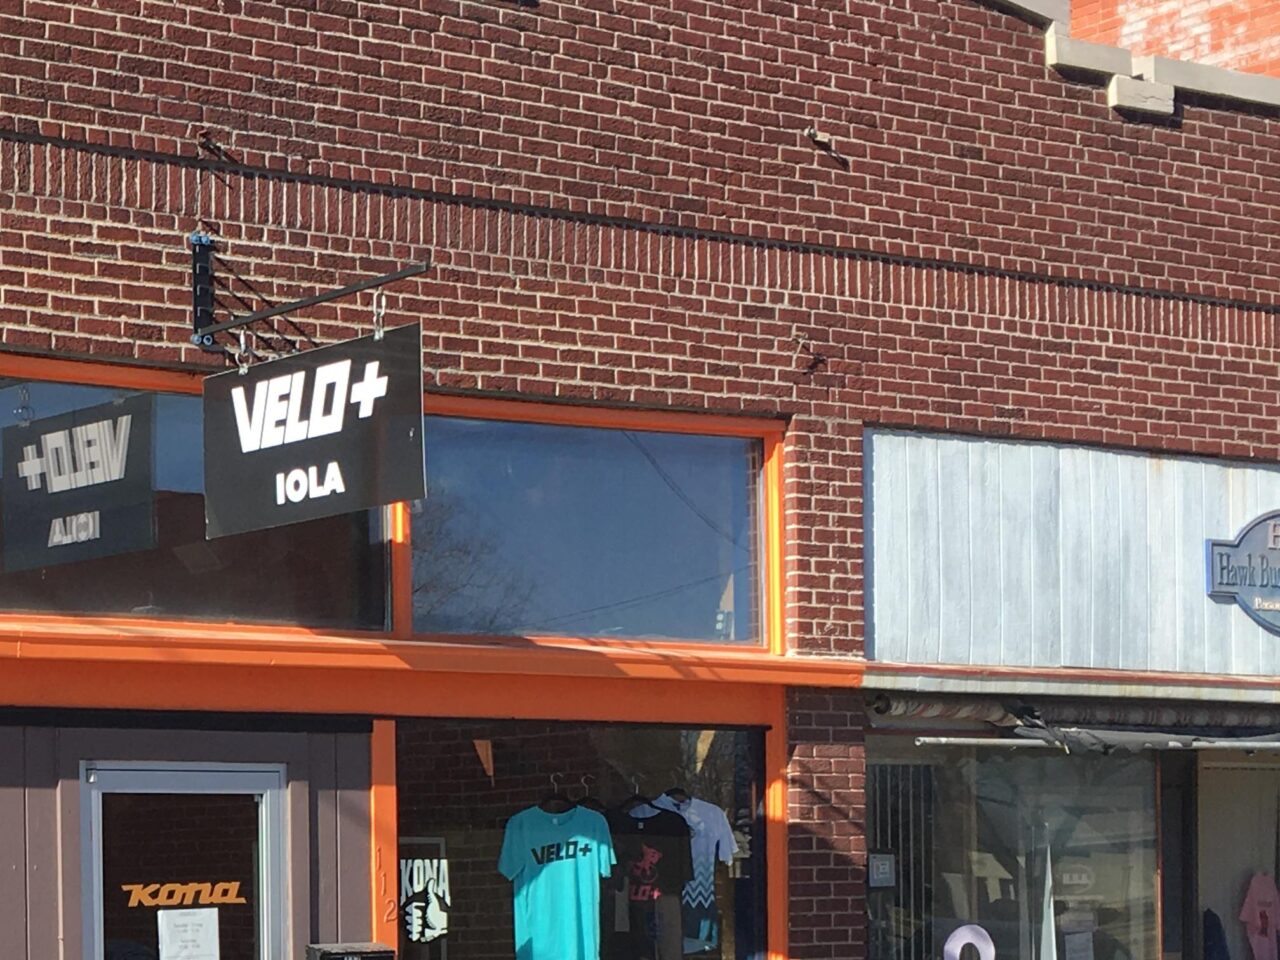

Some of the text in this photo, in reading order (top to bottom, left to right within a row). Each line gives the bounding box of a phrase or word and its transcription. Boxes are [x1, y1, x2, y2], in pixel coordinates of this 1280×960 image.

[231, 358, 388, 454] VELO+
[276, 461, 346, 505] IOLA
[1217, 552, 1256, 587] Hawk
[531, 840, 592, 865] VELO+
[400, 859, 451, 907] KONA
